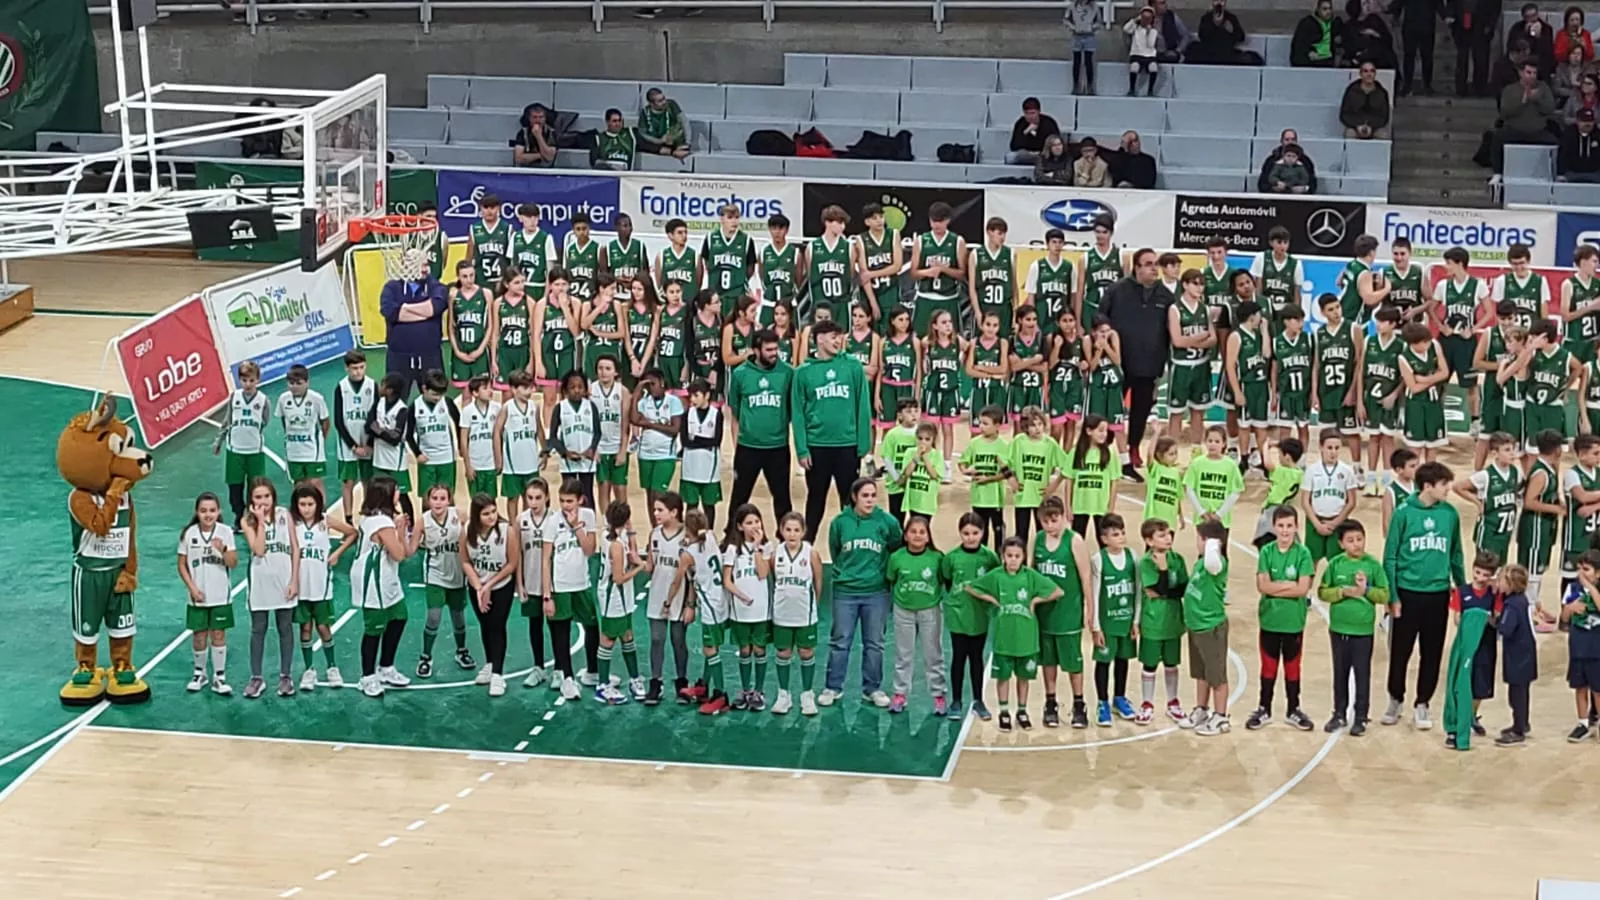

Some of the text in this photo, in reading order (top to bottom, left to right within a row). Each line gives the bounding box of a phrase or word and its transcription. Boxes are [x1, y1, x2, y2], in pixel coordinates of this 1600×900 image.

[1220, 204, 1277, 217] Automóvil
[1180, 217, 1254, 231] Concesionario
[1180, 231, 1260, 246] Merces-Benz
[482, 258, 503, 277] 54
[721, 270, 731, 289] 8
[822, 277, 842, 297] 00
[570, 282, 591, 298] 24
[984, 285, 1004, 304] 30
[1582, 316, 1598, 337] 21
[460, 327, 475, 343] 10
[504, 330, 522, 346] 48
[554, 334, 564, 350] 6
[144, 352, 202, 402] Lobe
[892, 368, 900, 382] 5
[940, 373, 948, 389] 2
[1022, 371, 1040, 387] 23
[1288, 372, 1304, 391] 11
[1324, 364, 1346, 385] 25
[707, 554, 723, 586] 3
[117, 613, 133, 628] 00
